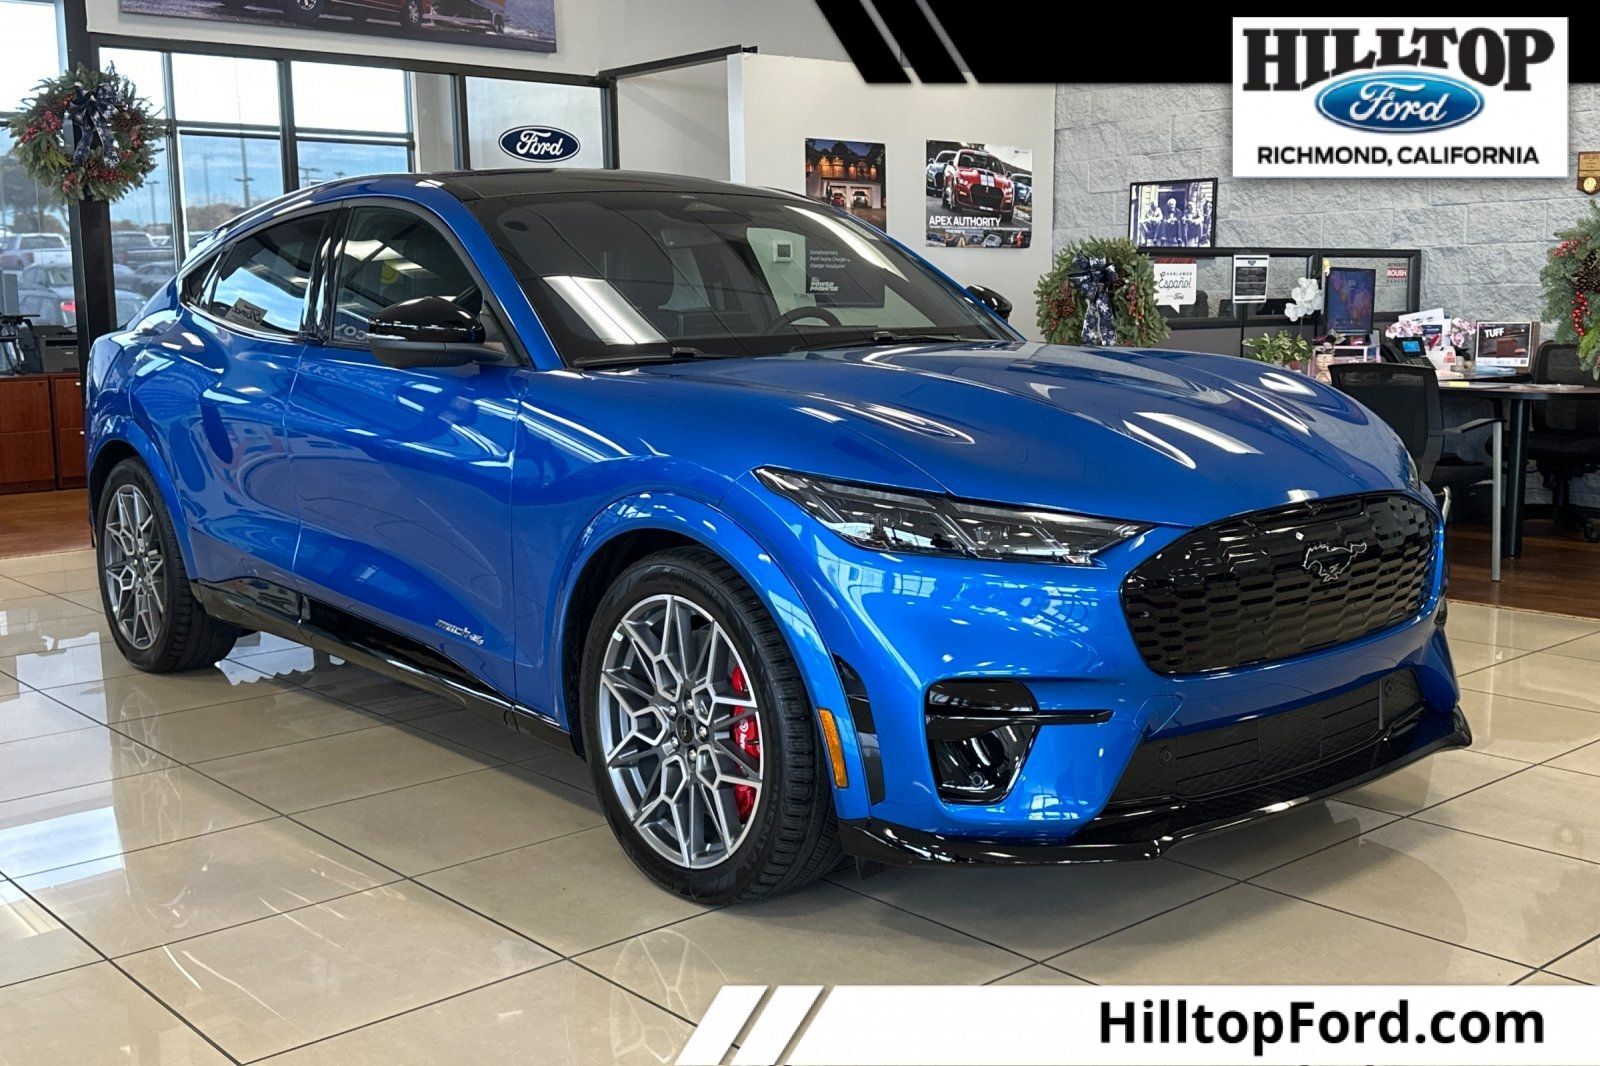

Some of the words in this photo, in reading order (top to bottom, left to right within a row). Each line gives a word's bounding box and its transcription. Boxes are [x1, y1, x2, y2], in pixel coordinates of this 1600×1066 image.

[516, 130, 564, 156] Ford
[929, 215, 952, 226] APEX
[953, 216, 1001, 227] AUTHORITY
[1484, 327, 1505, 338] TUFF
